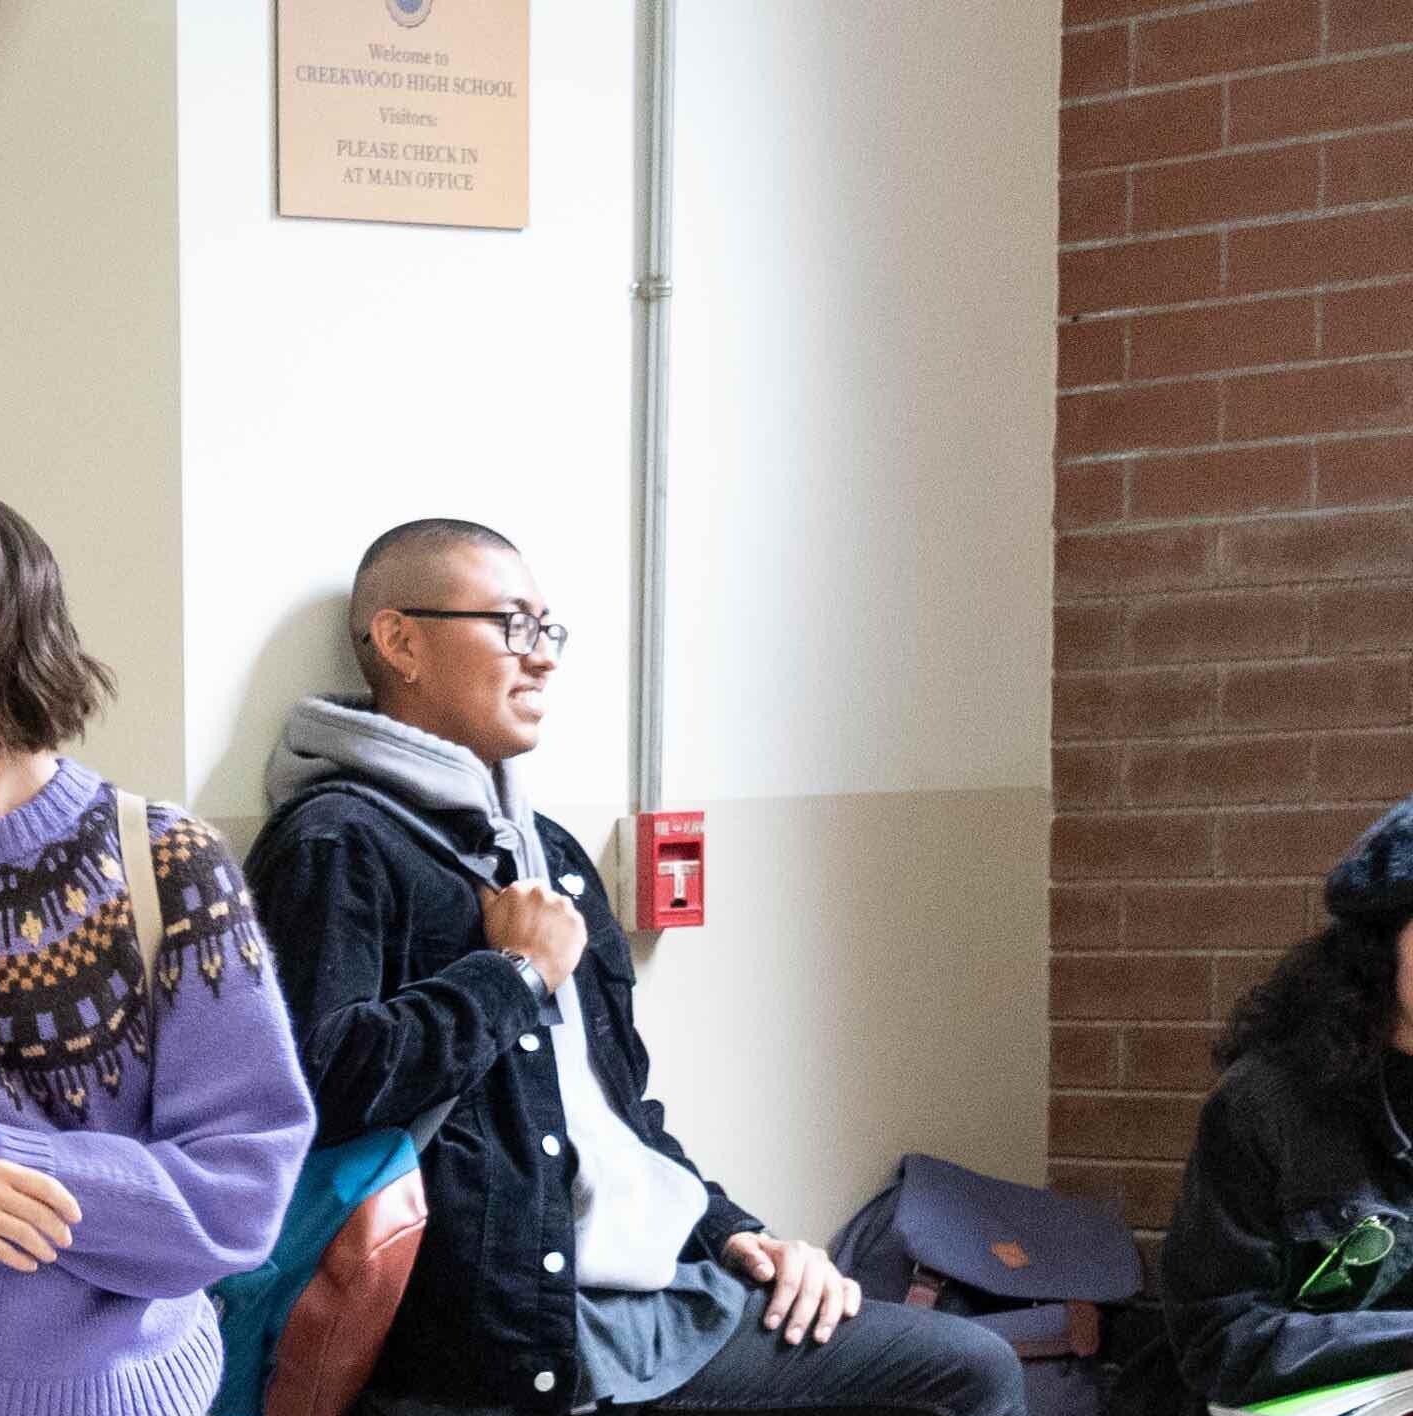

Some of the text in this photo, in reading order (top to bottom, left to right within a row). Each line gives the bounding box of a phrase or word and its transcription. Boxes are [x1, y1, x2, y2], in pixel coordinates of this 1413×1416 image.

[368, 43, 449, 66] Welcome to
[295, 65, 518, 98] CREEKWOOD HIGH SCHOOL
[336, 139, 479, 165] PLEASE CHECK IN
[342, 167, 474, 192] AT MAIN OFFICE
